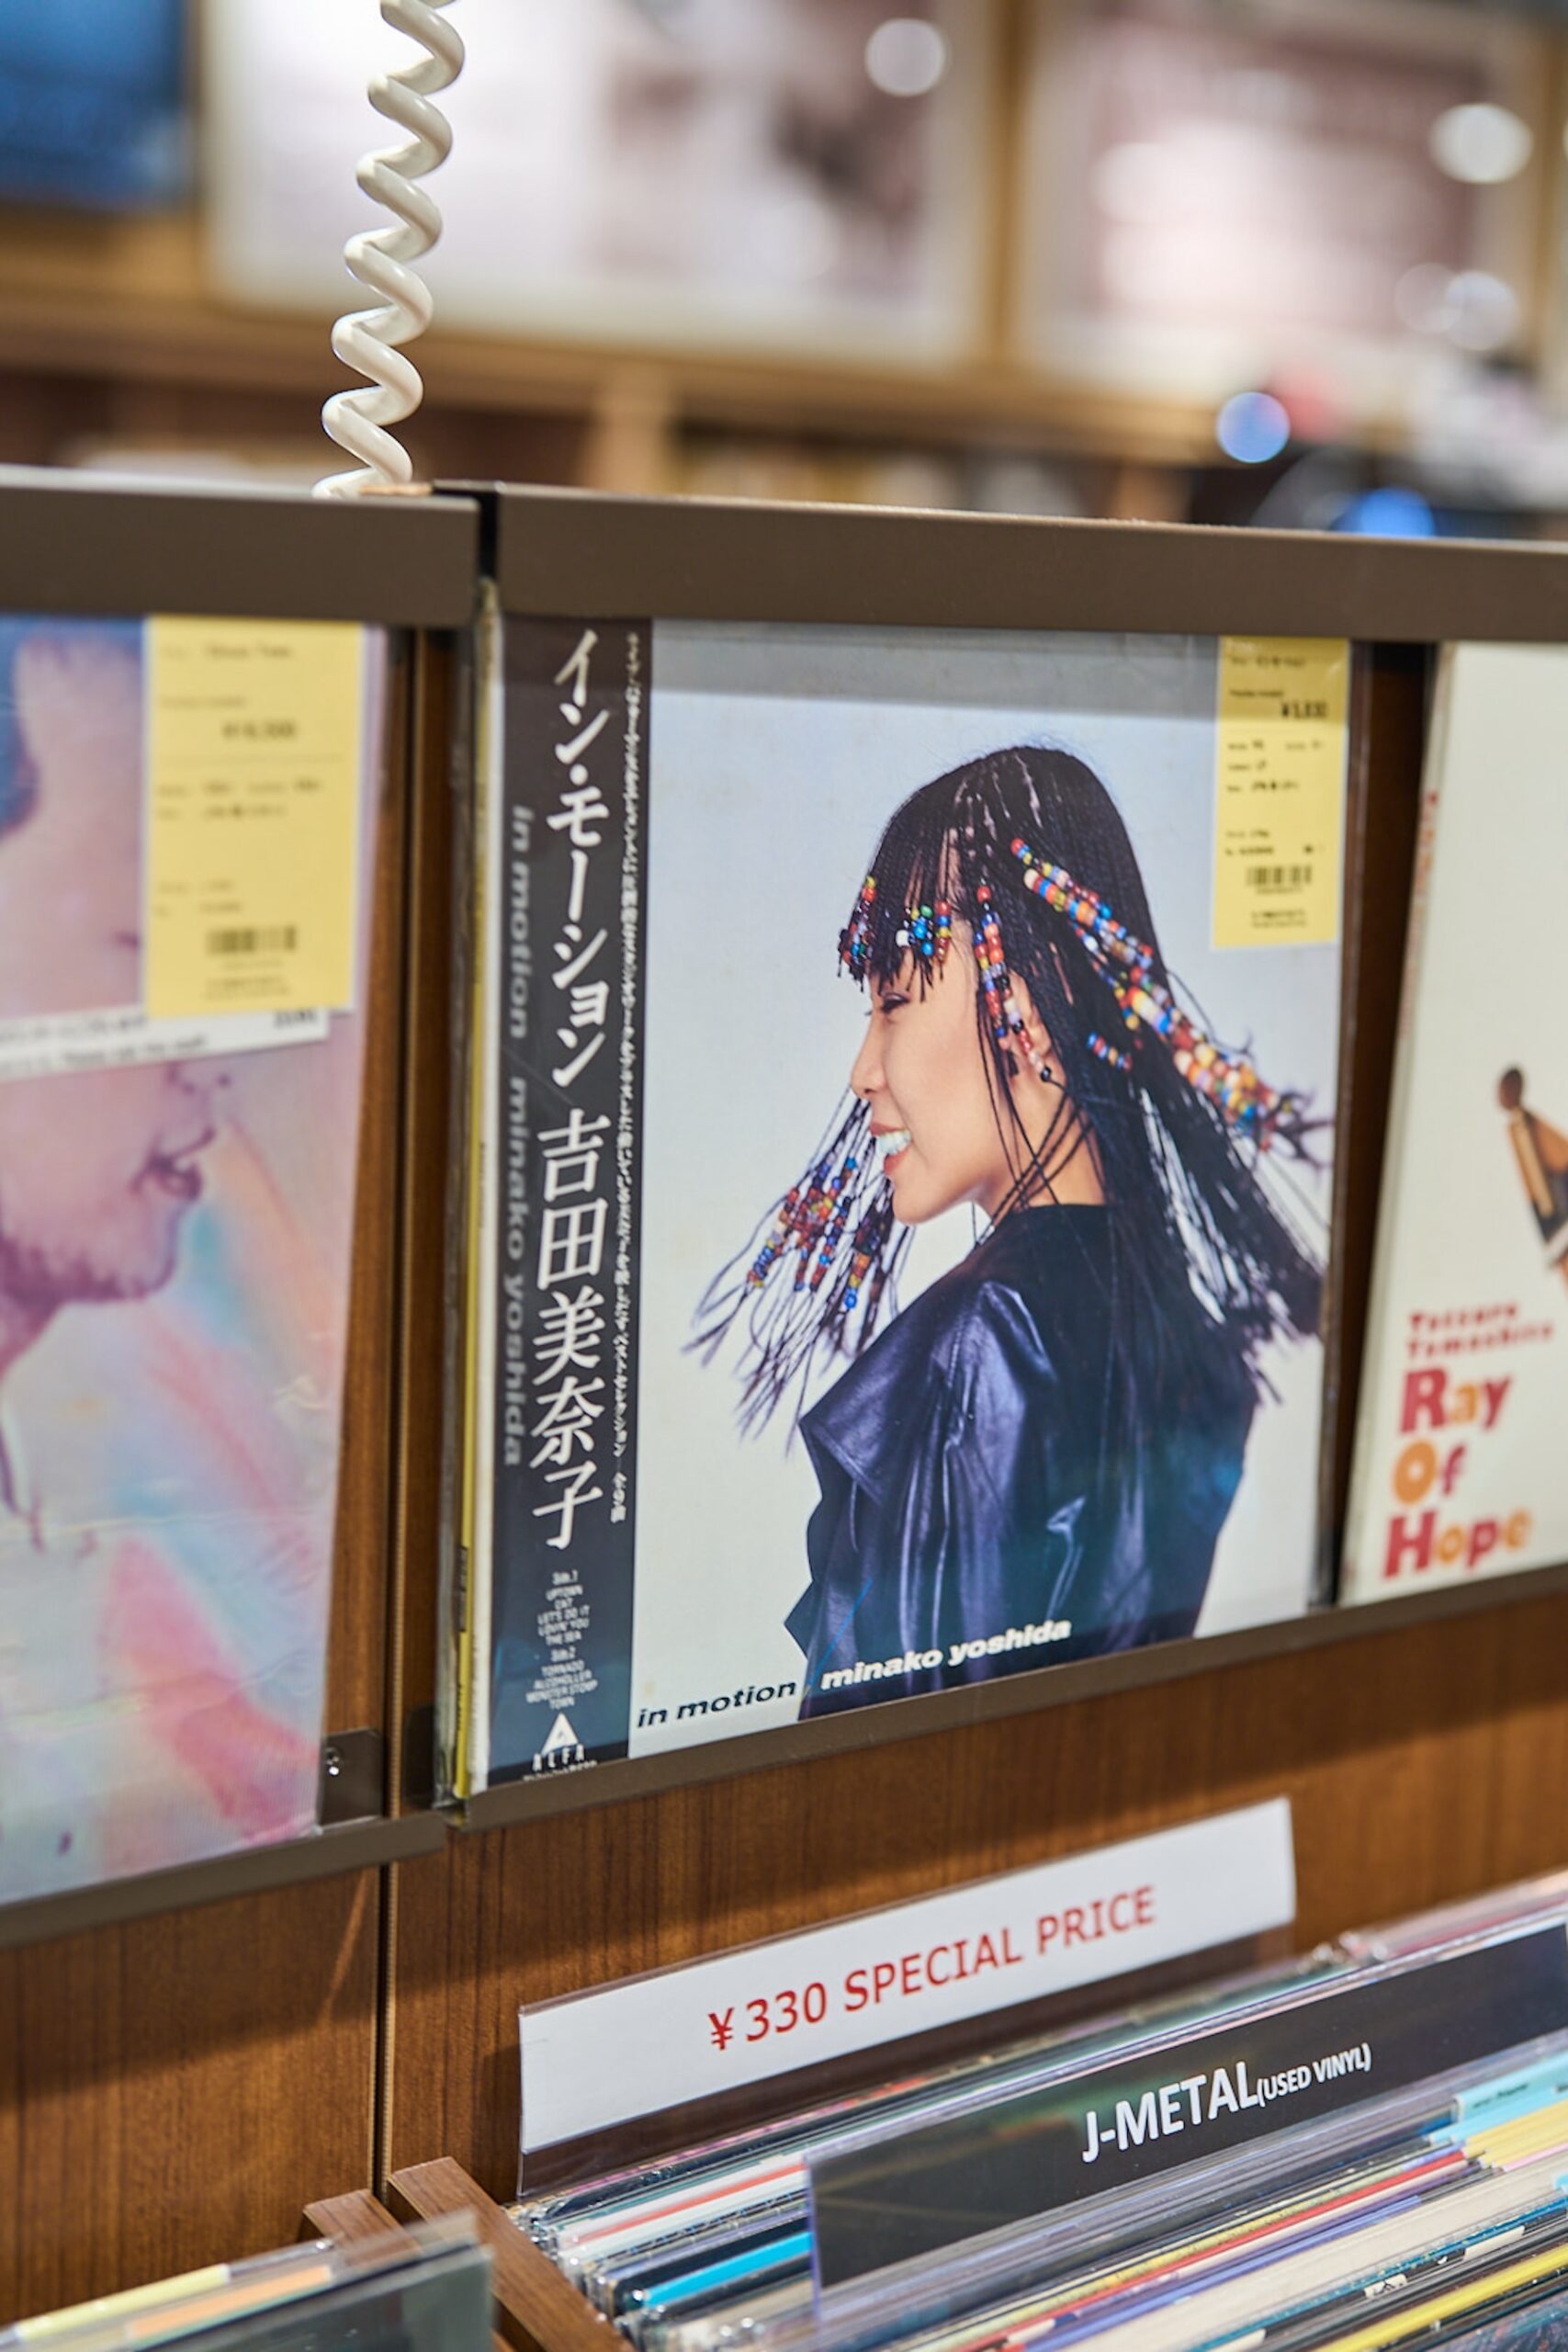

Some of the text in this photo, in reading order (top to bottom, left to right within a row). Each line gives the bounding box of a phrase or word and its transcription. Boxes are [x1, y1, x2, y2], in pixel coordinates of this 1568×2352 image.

[509, 860, 533, 1039] motion
[529, 628, 612, 1550] イン・モーション 吉田美奈子
[506, 1076, 530, 1261] minako
[503, 1273, 527, 1465] yoshida
[1401, 1368, 1511, 1433] Ray
[1392, 1440, 1467, 1506] Of
[1383, 1509, 1533, 1578] Hope
[637, 1620, 1072, 1728] in motion minako yoshida
[707, 1884, 1156, 2052] ¥330 SPECIAL PRICE
[1312, 2041, 1372, 2085] VINYL)
